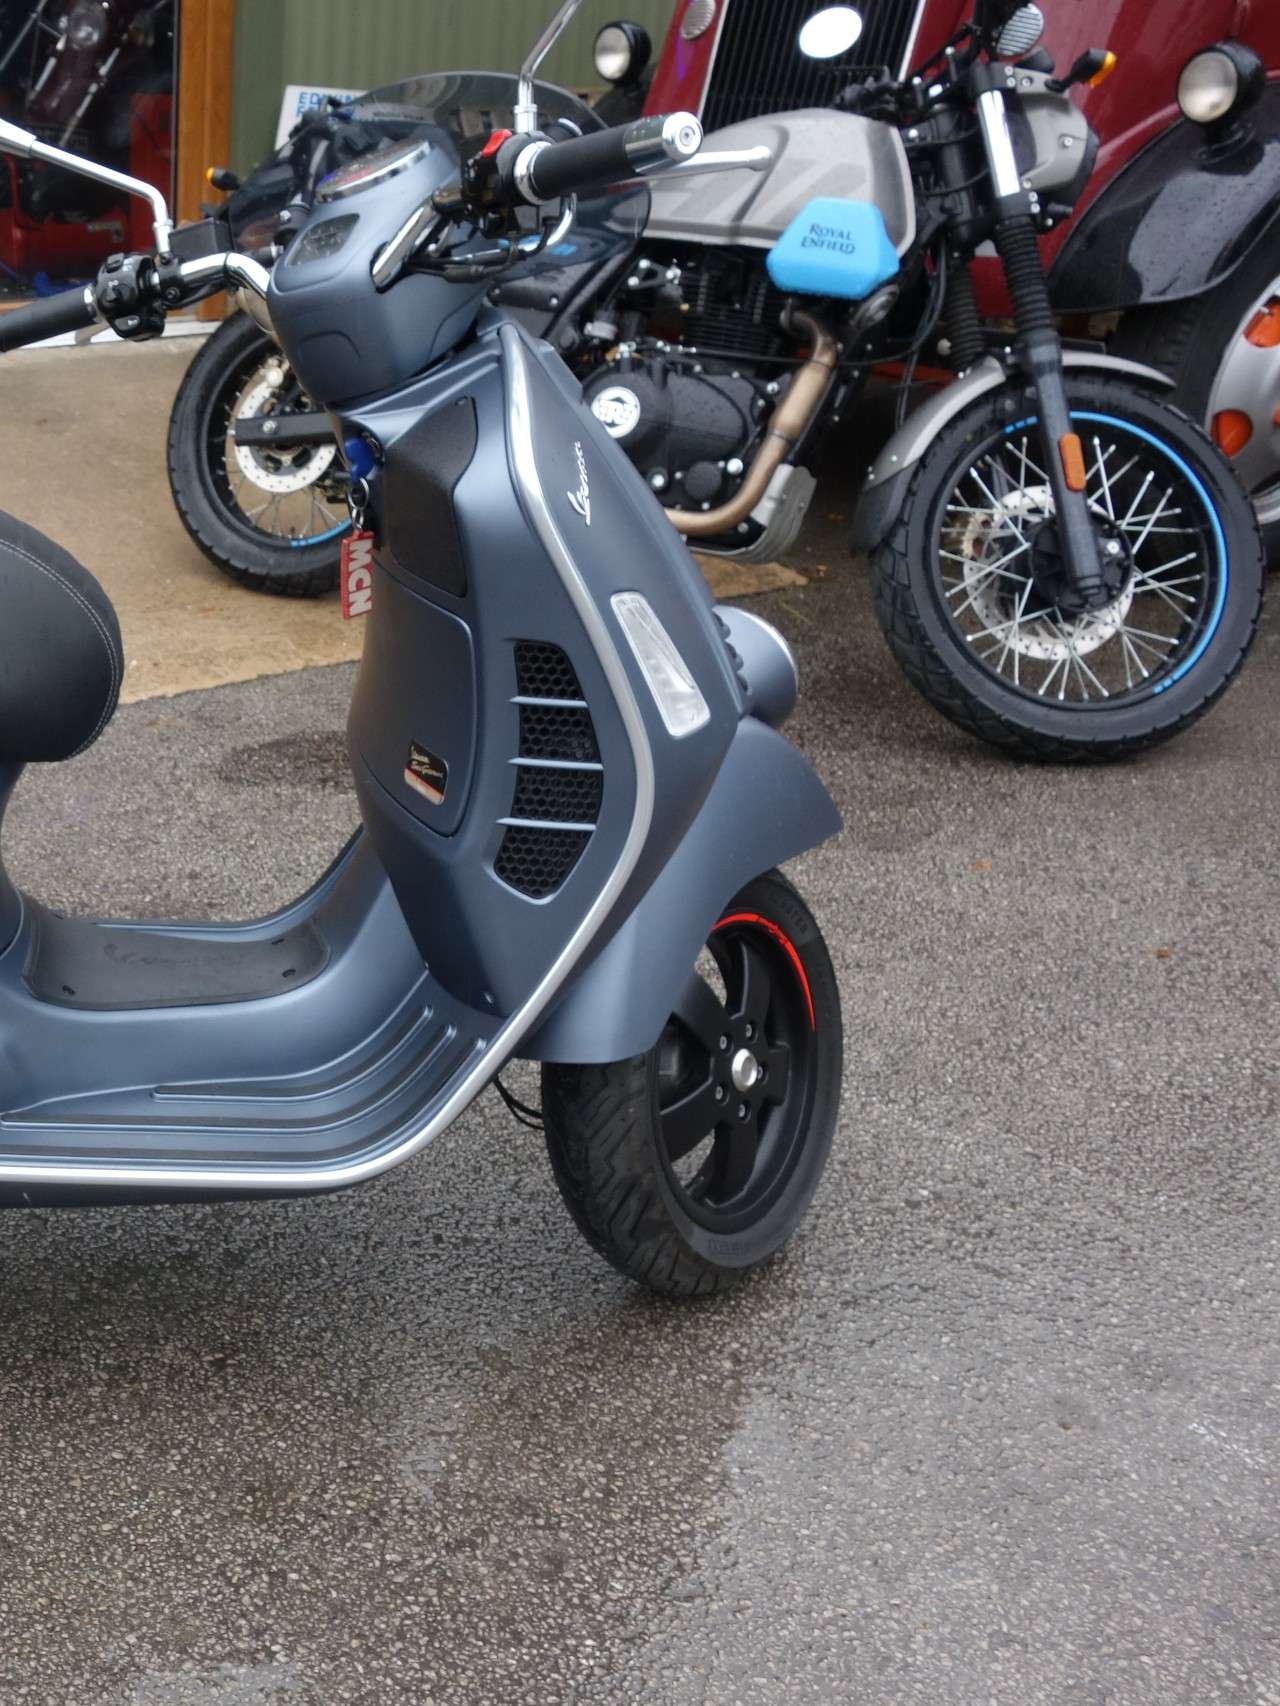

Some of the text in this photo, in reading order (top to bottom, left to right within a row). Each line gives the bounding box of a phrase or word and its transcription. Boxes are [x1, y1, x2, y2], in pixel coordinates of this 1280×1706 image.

[809, 223, 852, 241] ROYAL
[801, 235, 856, 255] ENFIELD
[348, 539, 373, 617] MCN
